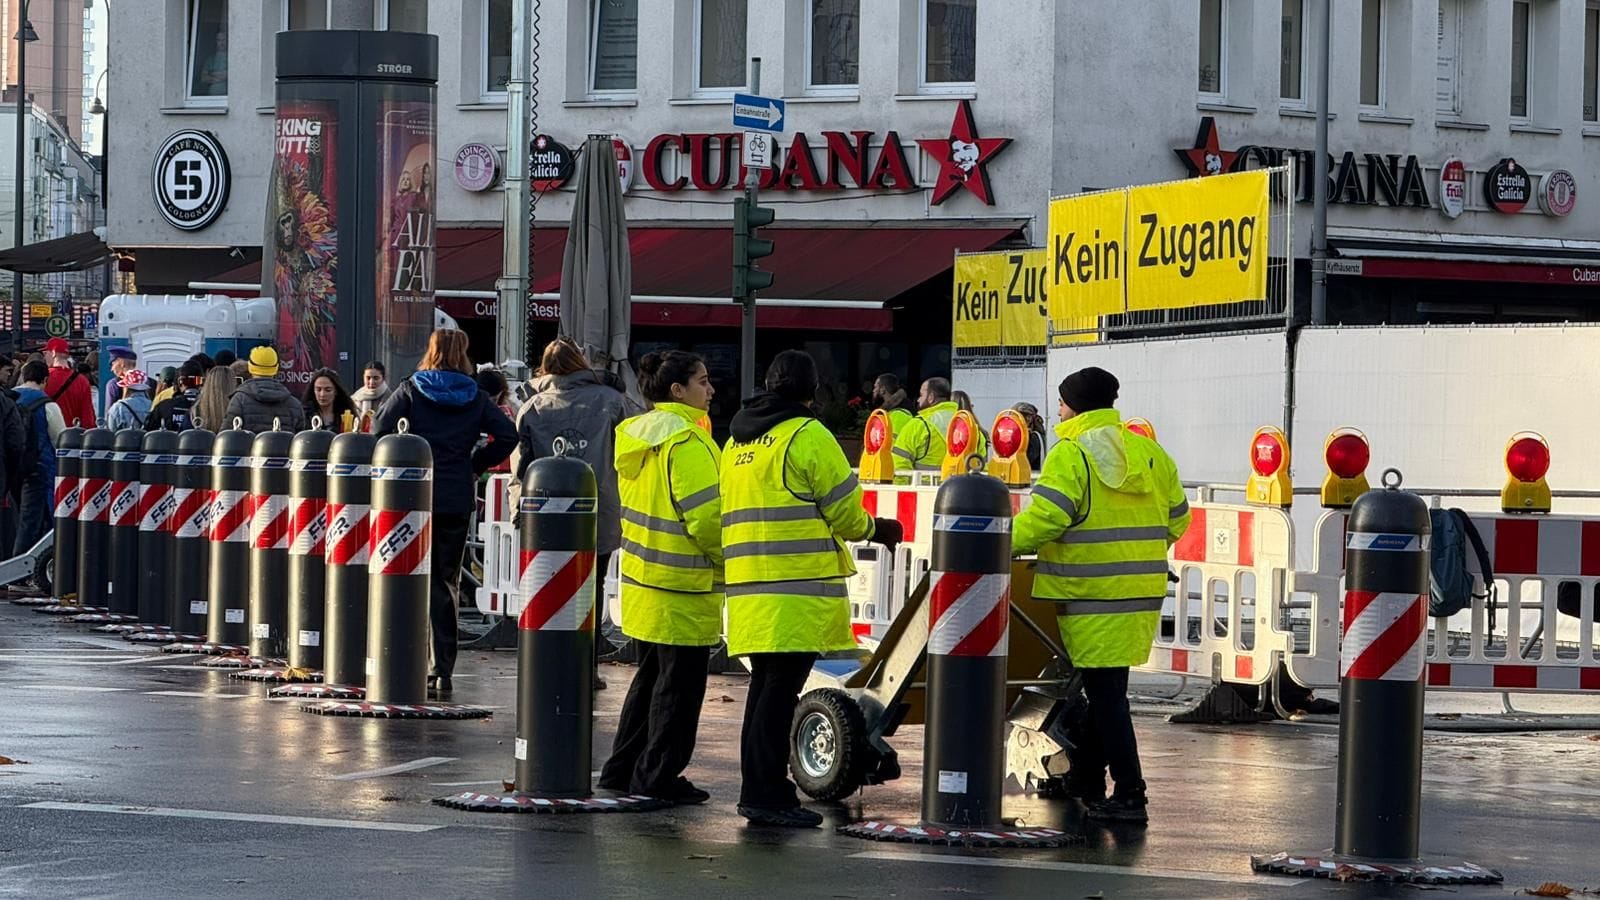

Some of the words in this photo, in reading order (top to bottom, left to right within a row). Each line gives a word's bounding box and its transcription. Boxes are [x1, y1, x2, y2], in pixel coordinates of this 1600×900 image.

[736, 105, 770, 119] Einbahnstraße
[282, 118, 322, 136] KING
[168, 138, 191, 157] CAFÉ
[456, 145, 492, 165] ERDINGER
[528, 151, 561, 164] strella
[174, 160, 203, 200] 5
[1497, 174, 1525, 187] Estrella
[1549, 172, 1575, 192] ERDINGER
[1446, 183, 1464, 198] früh
[1497, 187, 1524, 200] Galicia
[168, 204, 208, 218] COLOGNE
[1054, 229, 1119, 286] Kein
[1138, 213, 1256, 278] Zugang
[956, 280, 999, 322] Kein
[1007, 255, 1047, 317] Zug
[474, 301, 497, 316] Cub
[529, 302, 560, 317] Rest
[51, 319, 63, 333] H
[735, 451, 755, 466] 225
[65, 487, 80, 509] FF
[92, 482, 111, 509] FF
[112, 489, 135, 517] FFR
[193, 502, 211, 529] FF
[308, 512, 327, 546] FF
[379, 521, 415, 562] FFR
